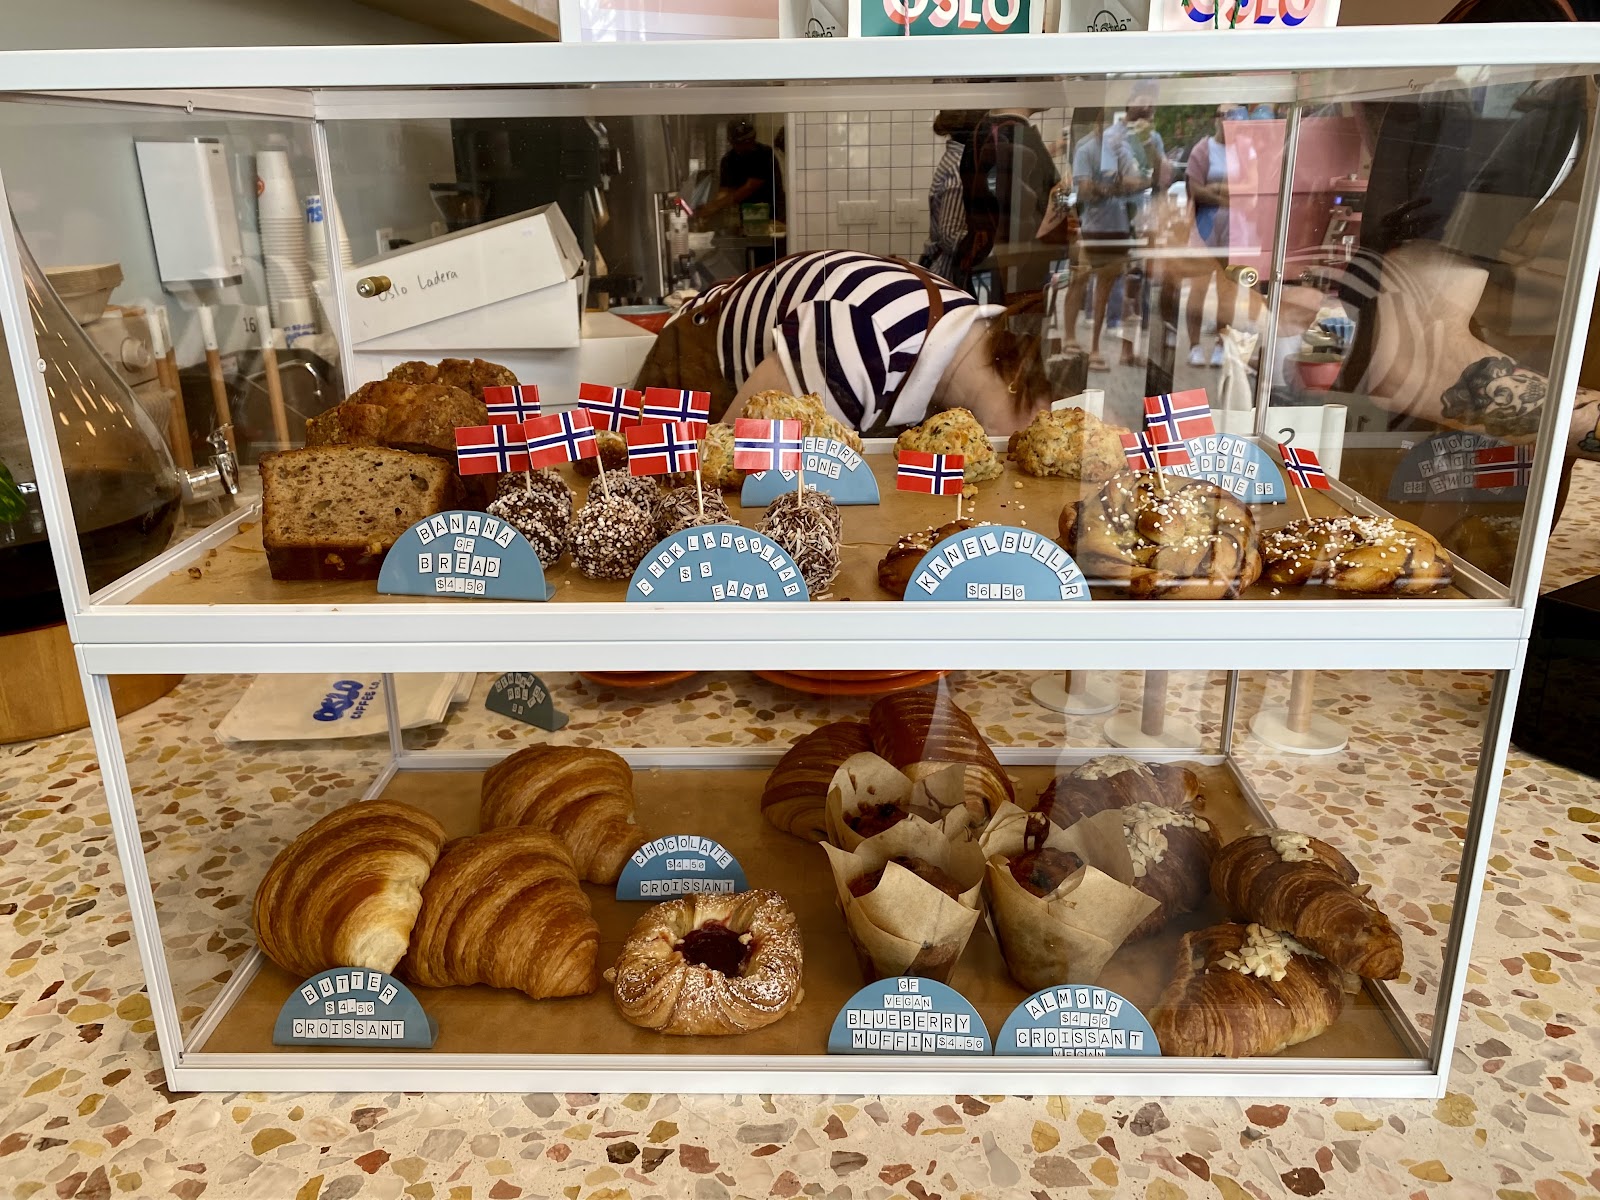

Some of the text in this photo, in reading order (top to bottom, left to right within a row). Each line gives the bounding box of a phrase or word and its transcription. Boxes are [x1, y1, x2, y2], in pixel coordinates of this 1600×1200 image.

[417, 269, 459, 290] Ladera
[243, 317, 257, 332] 16
[1192, 440, 1245, 454] ACON
[1174, 457, 1257, 476] HEDDAR
[1209, 476, 1247, 492] ONE
[1256, 484, 1273, 493] $5
[417, 516, 511, 546] BANANA
[455, 539, 473, 550] GF
[420, 556, 498, 574] BREAD
[639, 534, 798, 594] CHOKLADBOLLAR
[919, 535, 1080, 597] KANELBULLAR
[437, 579, 484, 592] $4.50
[713, 583, 767, 598] EACH
[968, 584, 1024, 598] $6.50
[634, 838, 730, 866] CHOCOLATE
[666, 860, 705, 871] $4.50
[641, 881, 734, 895] CROISSANT
[304, 973, 393, 1001] BUTTER
[899, 980, 917, 990] GF
[884, 997, 931, 1008] VEGAN
[1030, 992, 1118, 1014] ALMOND
[848, 1013, 969, 1030] BLUEBERRY
[1061, 1013, 1109, 1025] $4.50
[294, 1022, 403, 1036] CROISSANT
[854, 1033, 984, 1049] MUFFIN $4.50
[1018, 1031, 1140, 1047] CROISSANT
